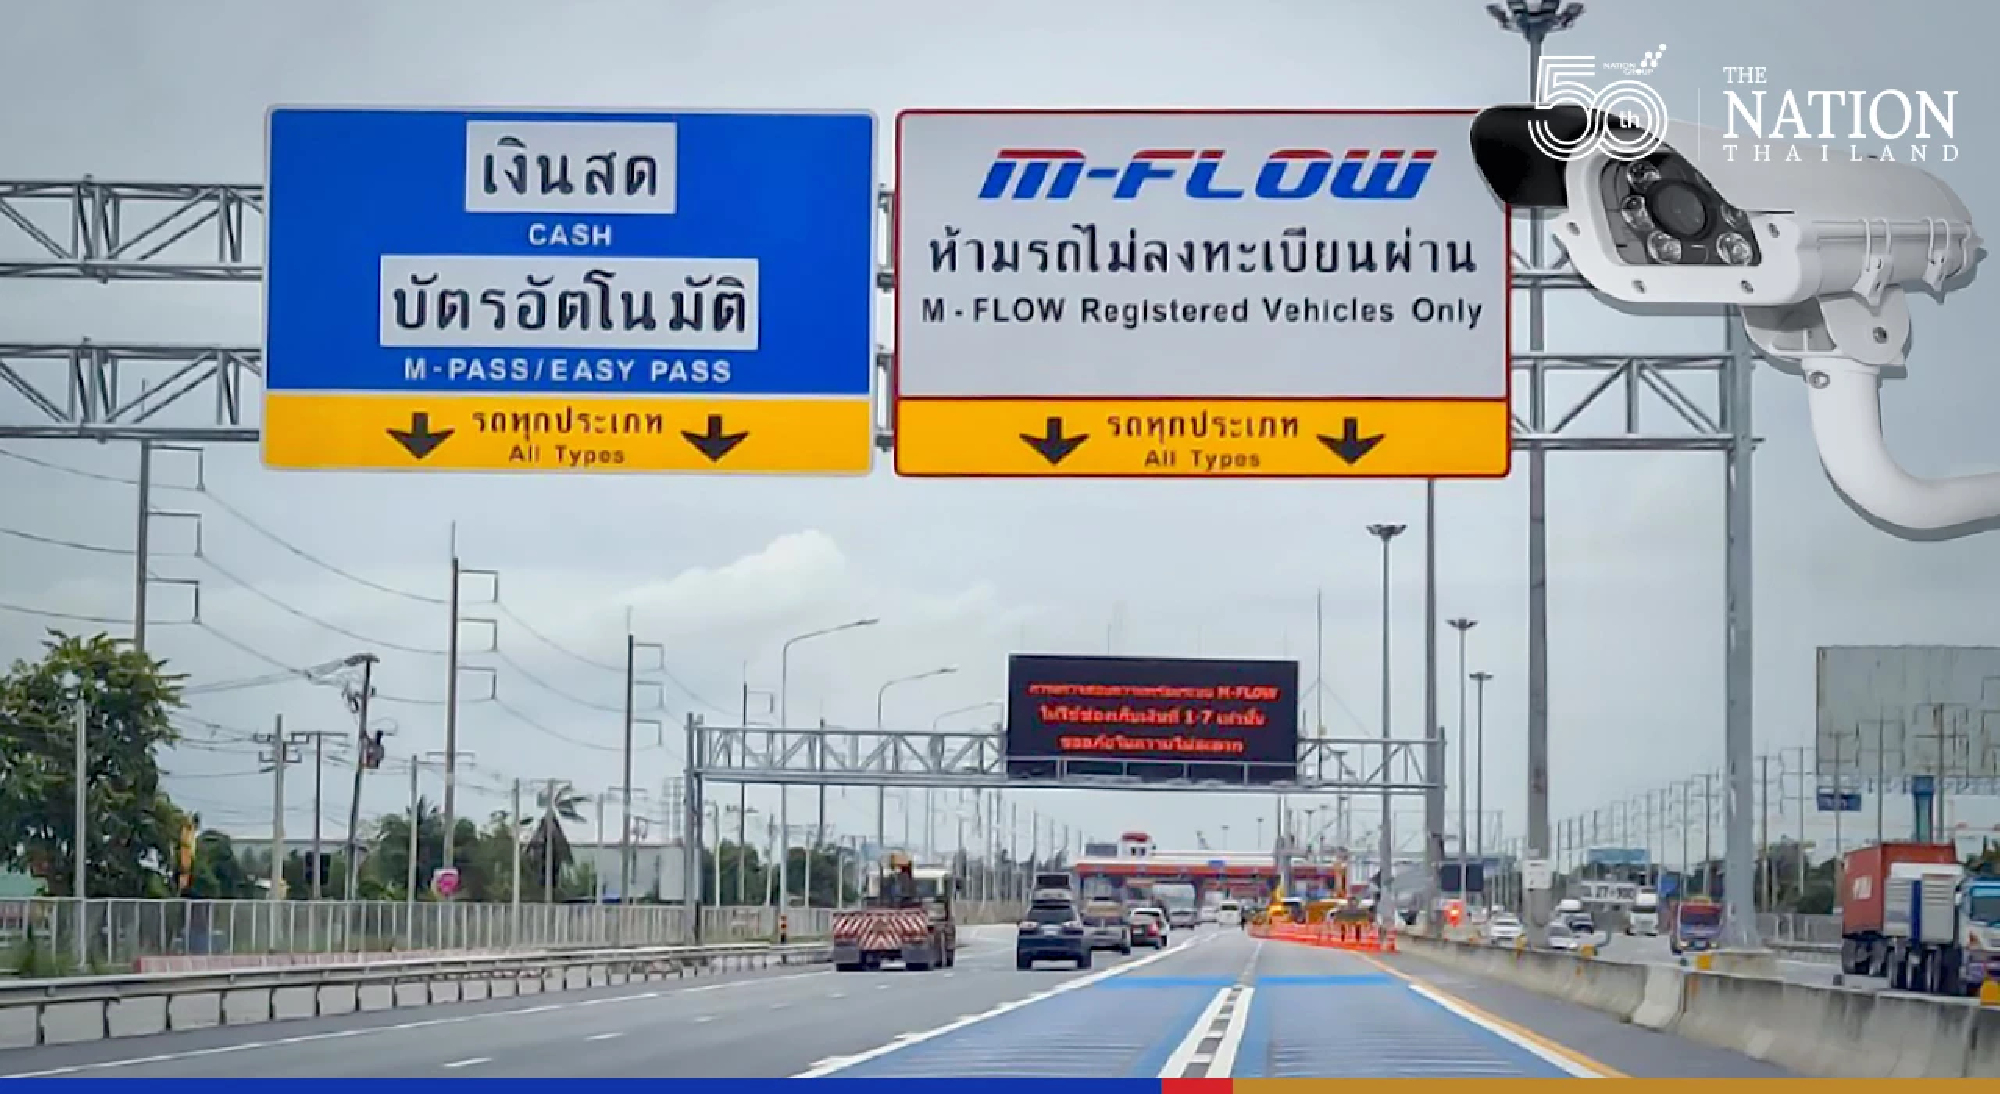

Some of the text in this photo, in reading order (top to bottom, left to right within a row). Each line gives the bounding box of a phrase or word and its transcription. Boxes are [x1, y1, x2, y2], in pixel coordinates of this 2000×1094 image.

[483, 135, 657, 197] เงินสด
[529, 223, 611, 246] CASH
[929, 223, 1478, 274] ห้ามรถไม่ลงทะเบียนผ่าน
[393, 269, 746, 333] บัตรอัตโนมัติ
[1081, 297, 1248, 330] Registered
[1261, 298, 1395, 323] Vehicles
[1411, 298, 1483, 330] Only
[651, 360, 732, 383] PASS
[472, 405, 663, 441] รถทุกประเภท
[1106, 409, 1299, 444] รถทุกประเภท
[509, 445, 625, 467] All Types
[1144, 450, 1261, 471] All Types
